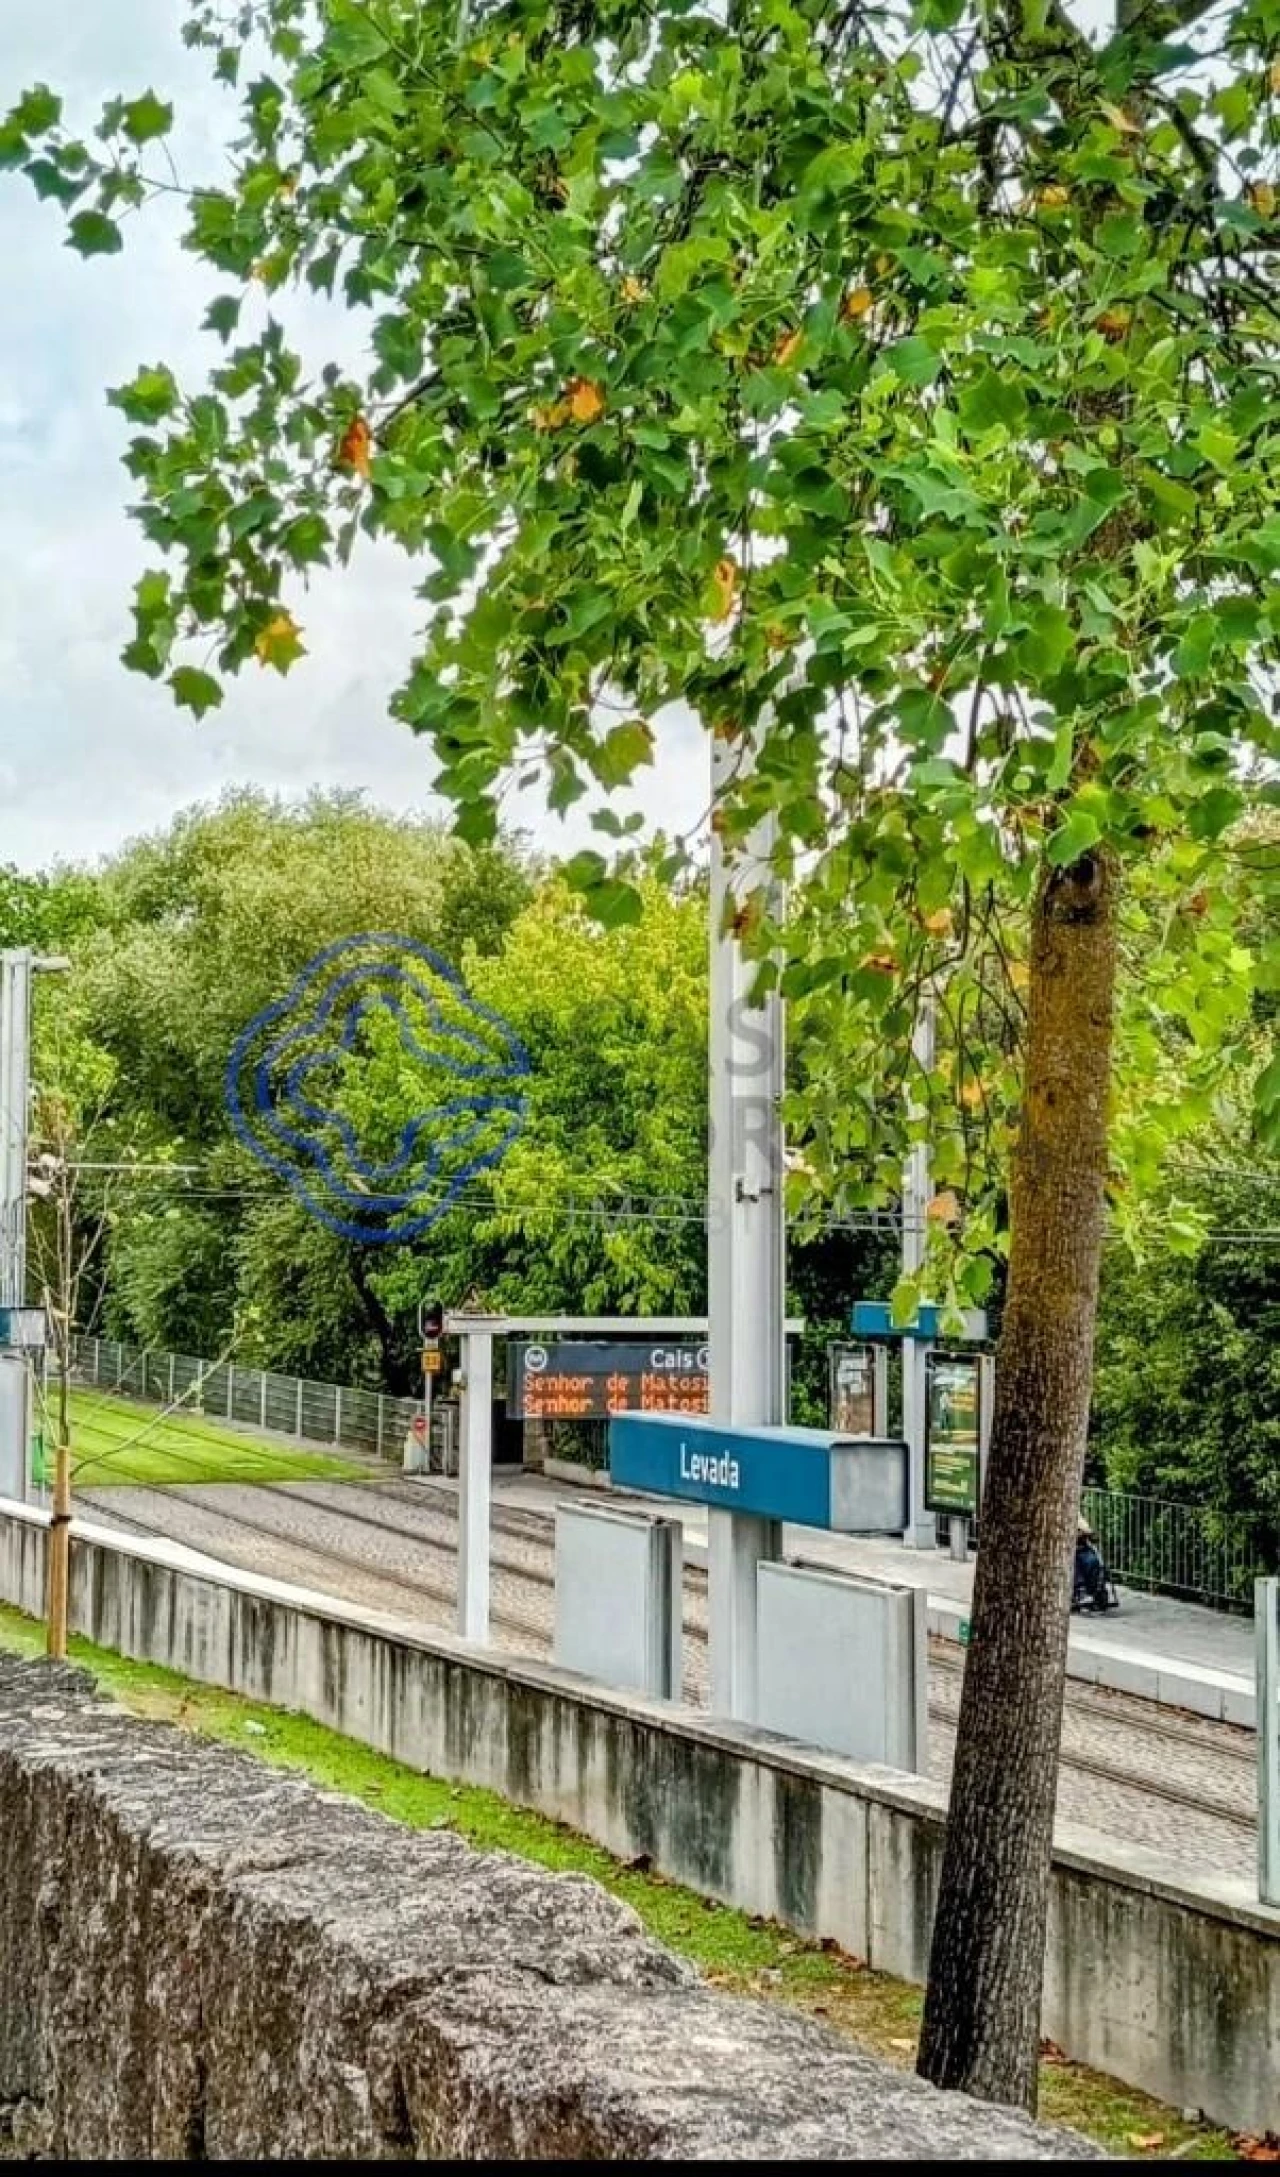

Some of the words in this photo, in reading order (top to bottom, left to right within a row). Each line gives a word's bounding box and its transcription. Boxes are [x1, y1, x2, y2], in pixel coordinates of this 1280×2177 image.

[524, 1373, 593, 1392] Senhor
[606, 1371, 630, 1392] de
[524, 1394, 593, 1413] Senhor
[606, 1393, 630, 1412] de
[680, 1442, 739, 1489] Levada
